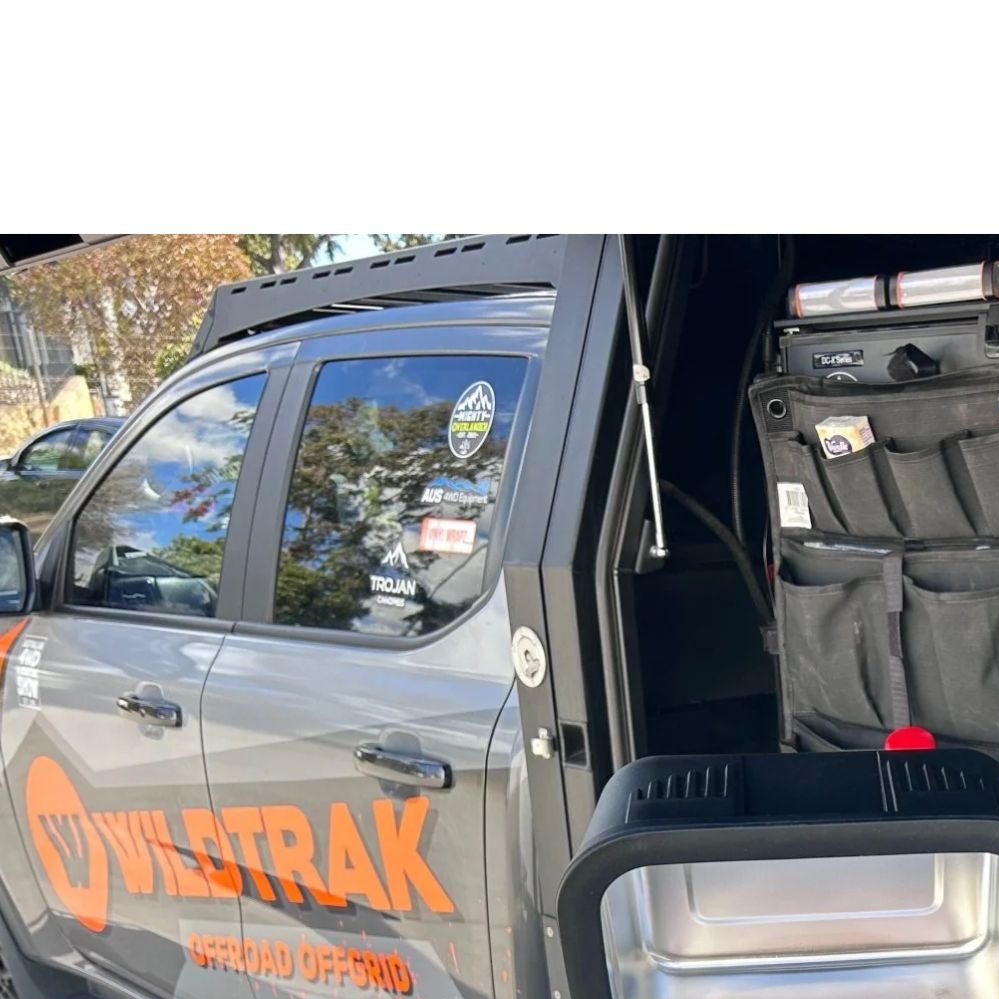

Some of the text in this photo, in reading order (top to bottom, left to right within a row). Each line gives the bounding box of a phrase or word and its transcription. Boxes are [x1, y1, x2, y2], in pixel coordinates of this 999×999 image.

[457, 410, 487, 422] MIGHTY
[421, 487, 444, 502] AUS
[369, 575, 417, 596] TROJAN
[92, 796, 455, 913] WILDTRAK
[188, 932, 414, 995] OFFROAD OFFGRID
